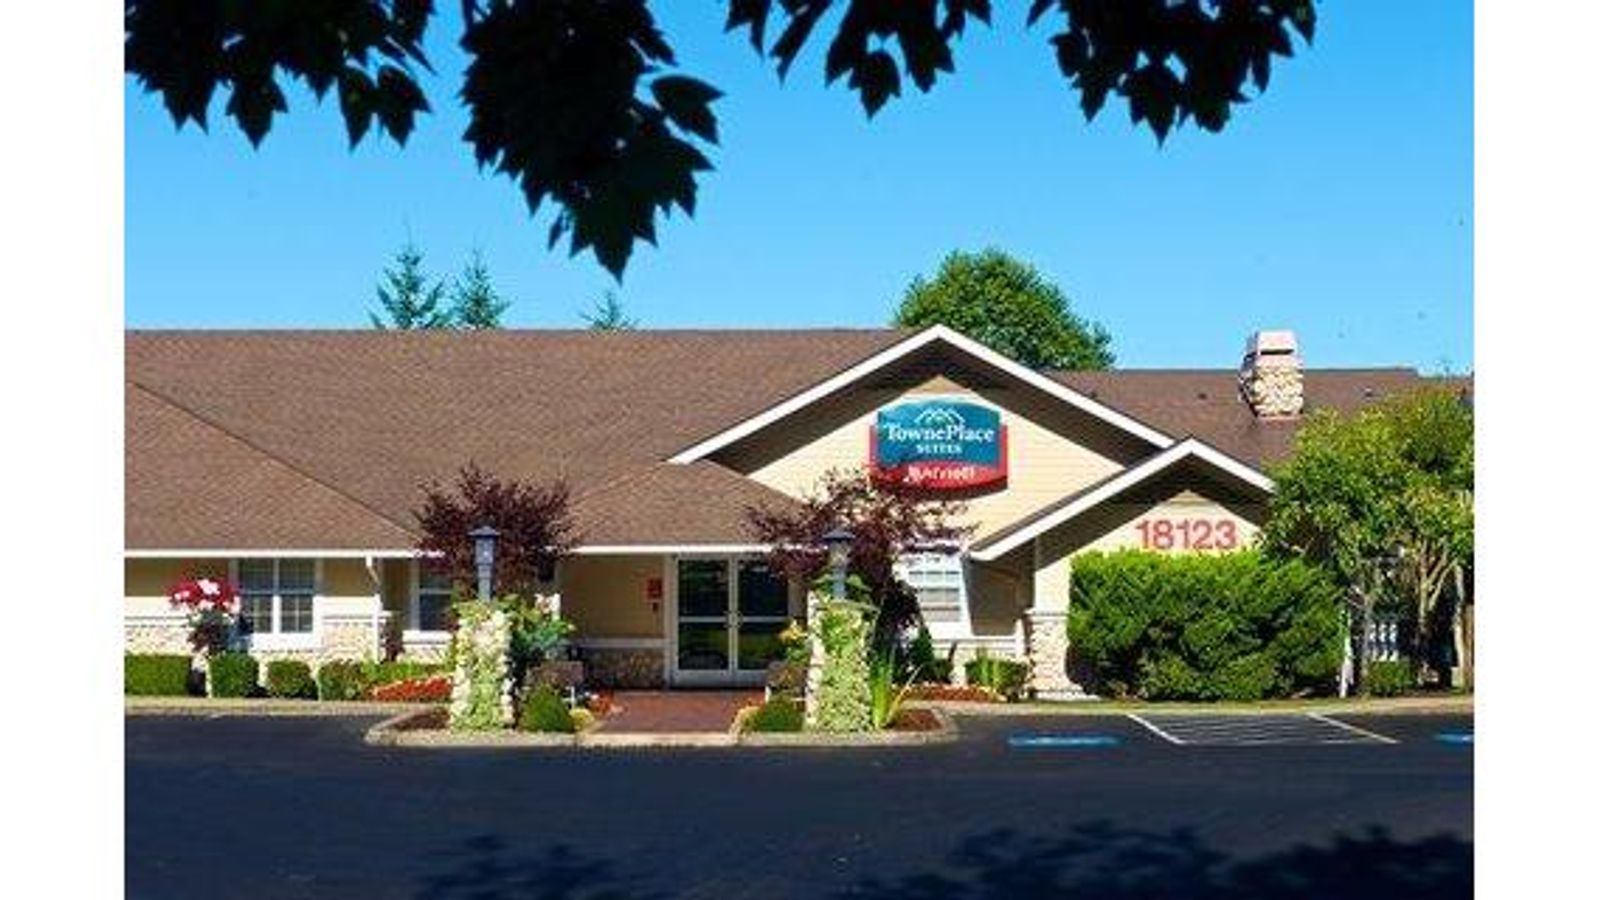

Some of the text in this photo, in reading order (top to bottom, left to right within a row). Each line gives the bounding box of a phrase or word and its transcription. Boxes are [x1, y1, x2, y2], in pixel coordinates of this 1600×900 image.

[883, 422, 995, 442] TownePlace
[916, 444, 962, 454] SUITES
[1136, 519, 1236, 549] 18123
